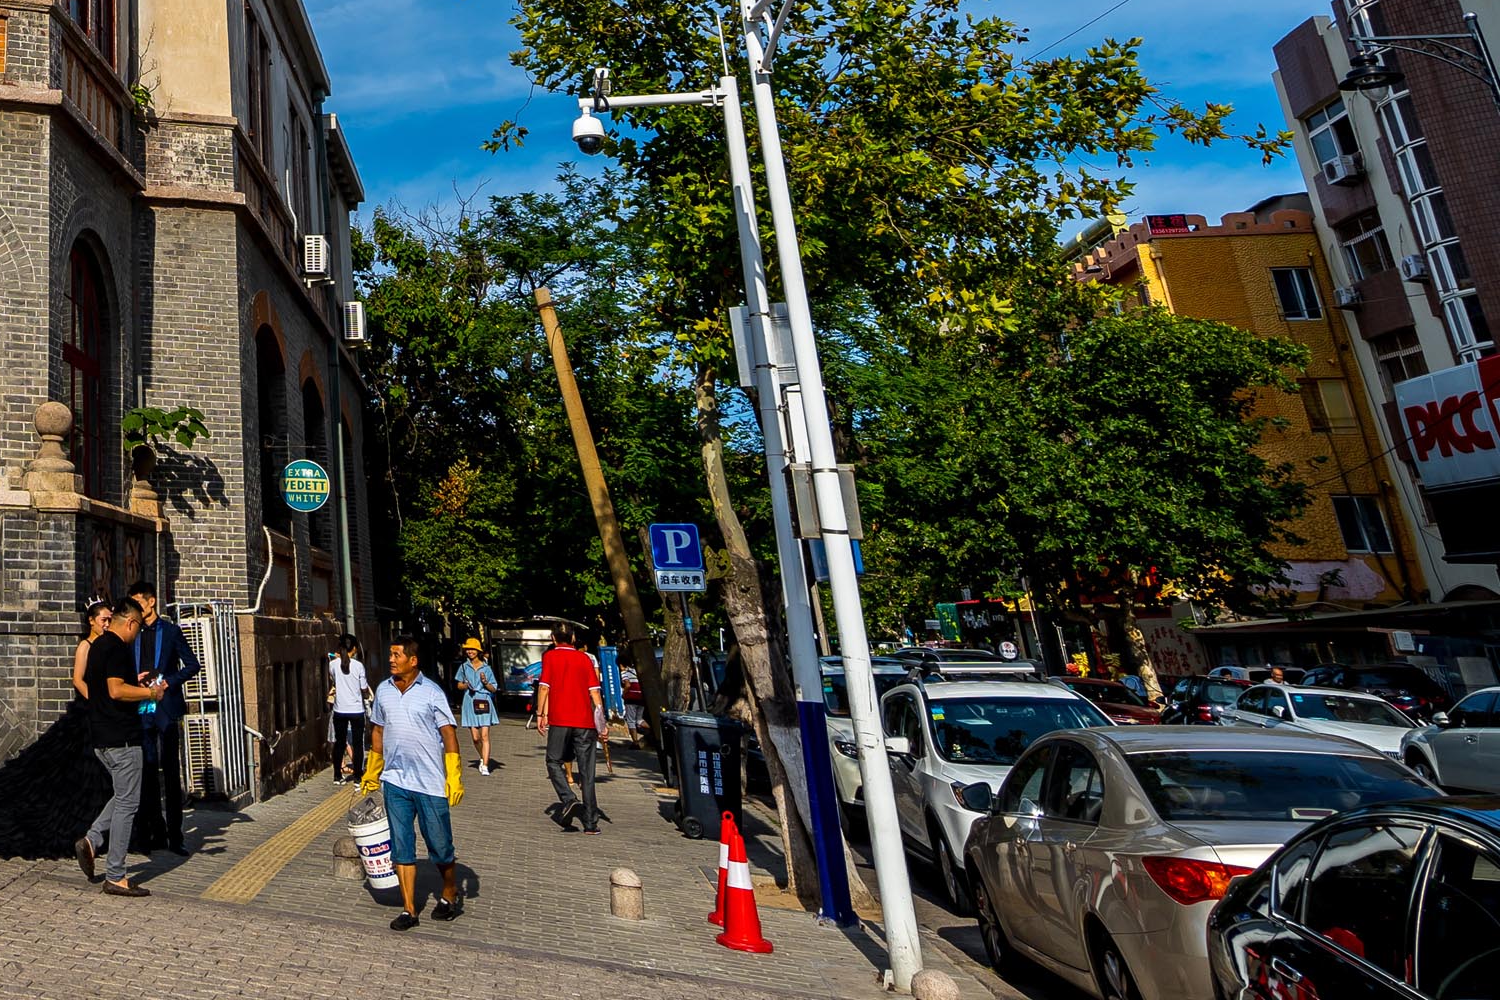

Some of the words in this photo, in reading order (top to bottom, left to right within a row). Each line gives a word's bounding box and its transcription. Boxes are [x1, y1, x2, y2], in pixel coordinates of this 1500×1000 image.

[1404, 390, 1496, 462] PICC
[288, 468, 321, 477] EXTRA
[283, 480, 326, 491] VEDETT
[289, 494, 321, 503] WHITE
[660, 529, 691, 564] P
[660, 574, 701, 585] 泊车收费
